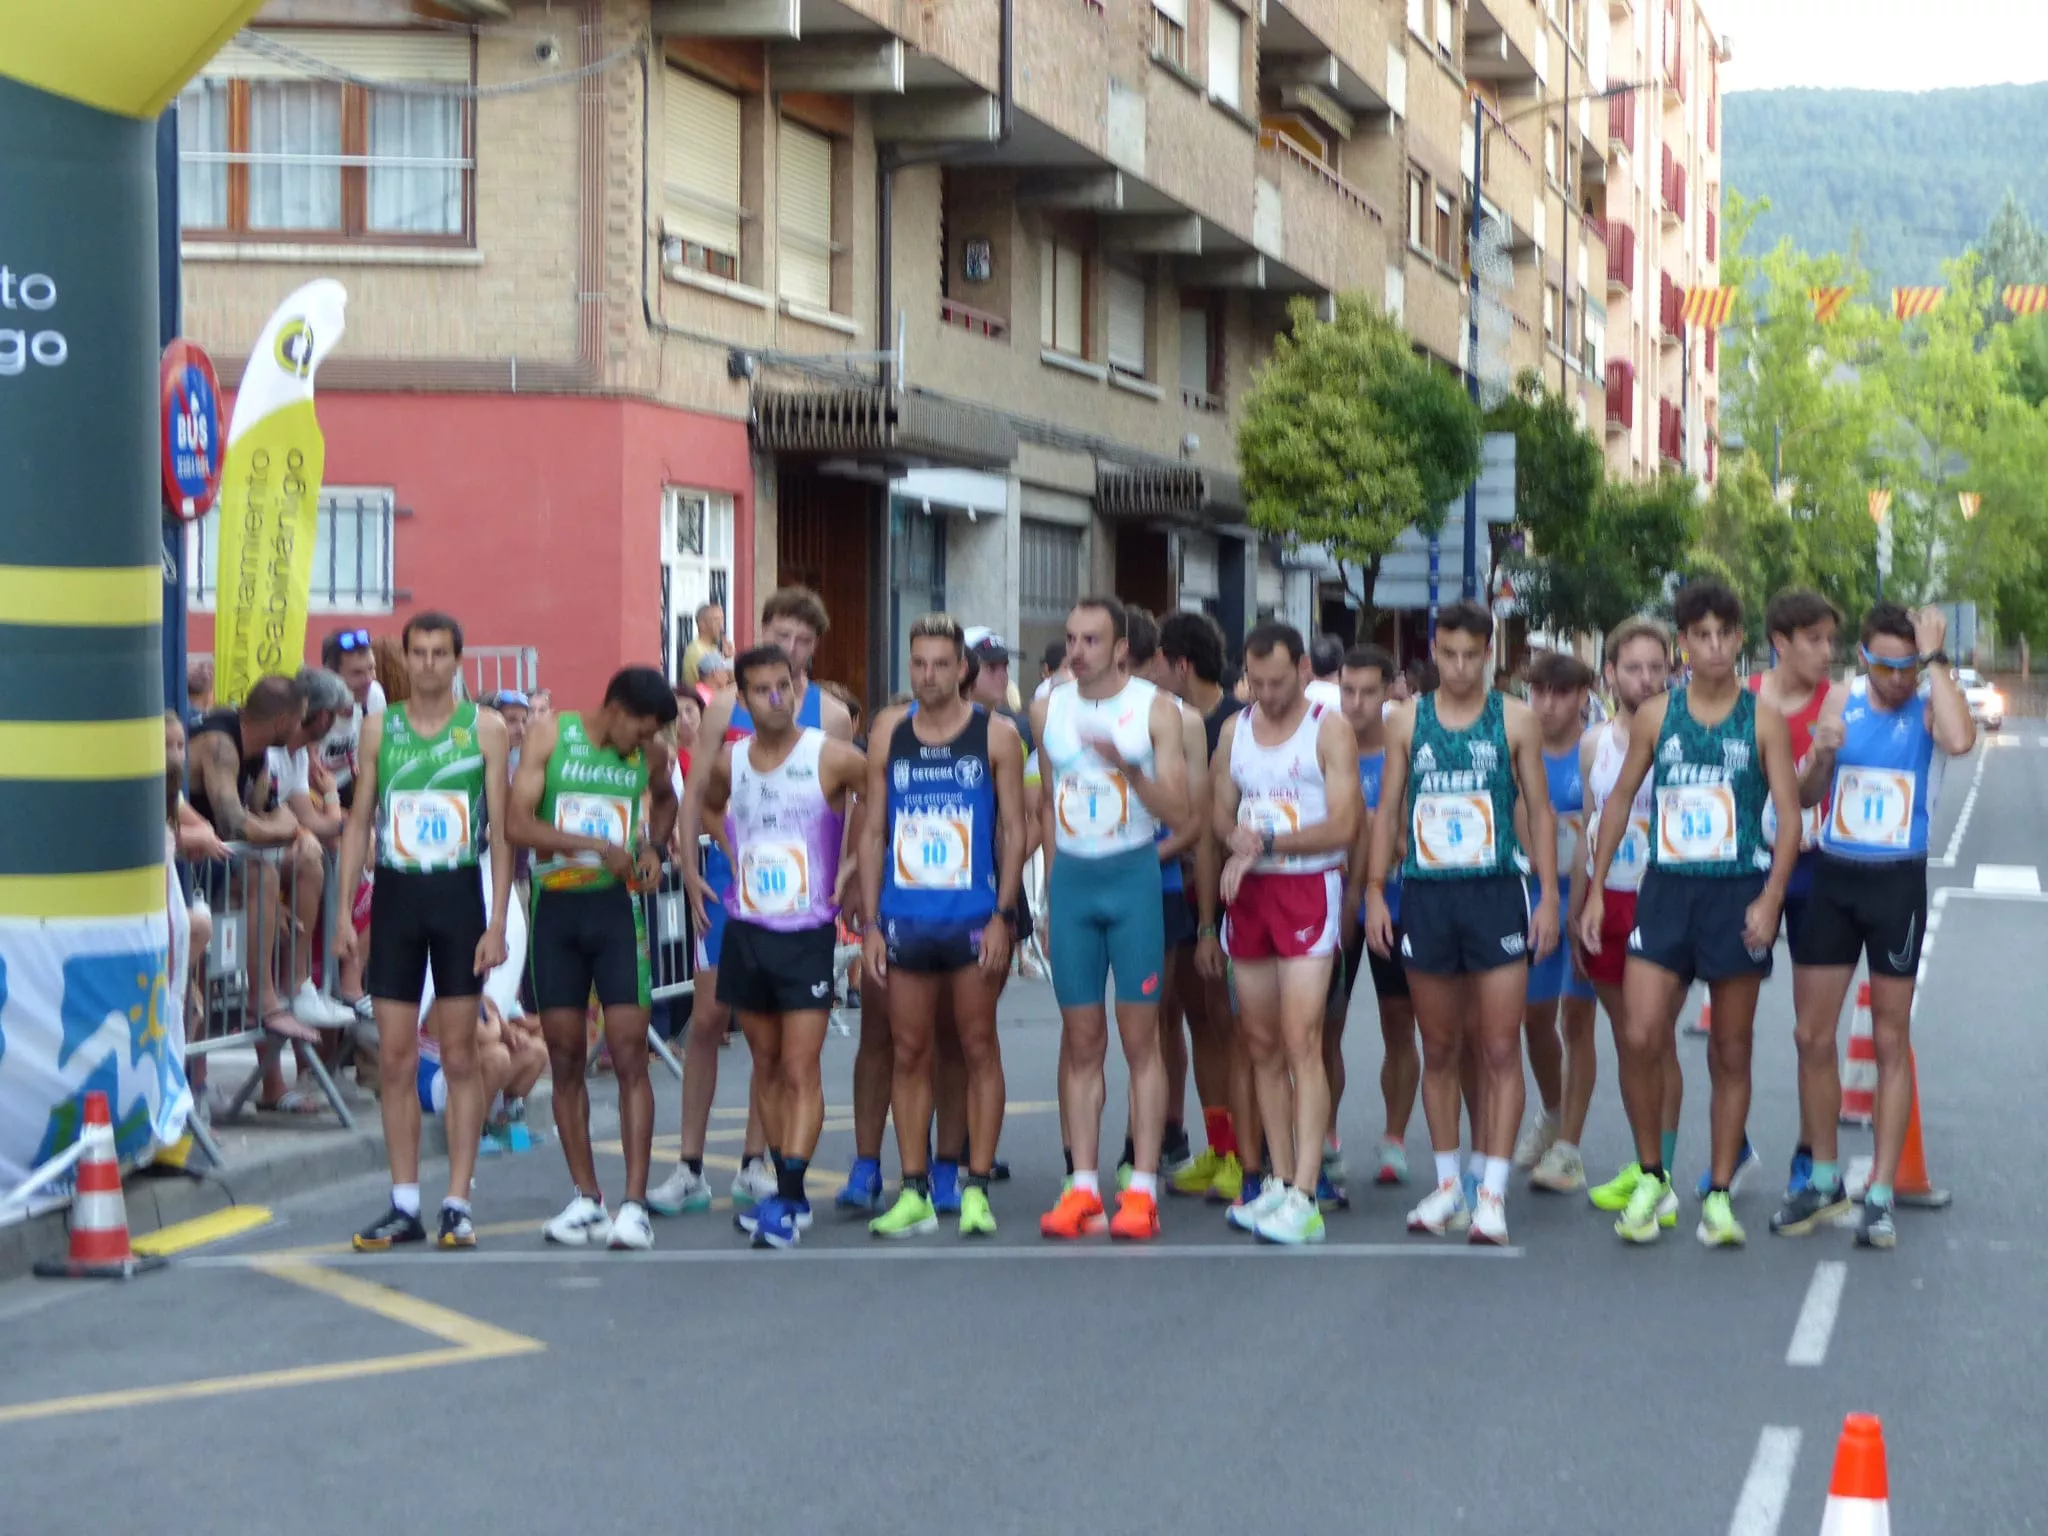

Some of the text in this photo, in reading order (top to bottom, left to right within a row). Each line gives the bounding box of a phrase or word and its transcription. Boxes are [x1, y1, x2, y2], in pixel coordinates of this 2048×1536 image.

[177, 413, 208, 450] BUS
[1089, 794, 1097, 820] 1
[1864, 793, 1884, 823] 11
[416, 817, 447, 842] 20
[923, 841, 948, 866] 10
